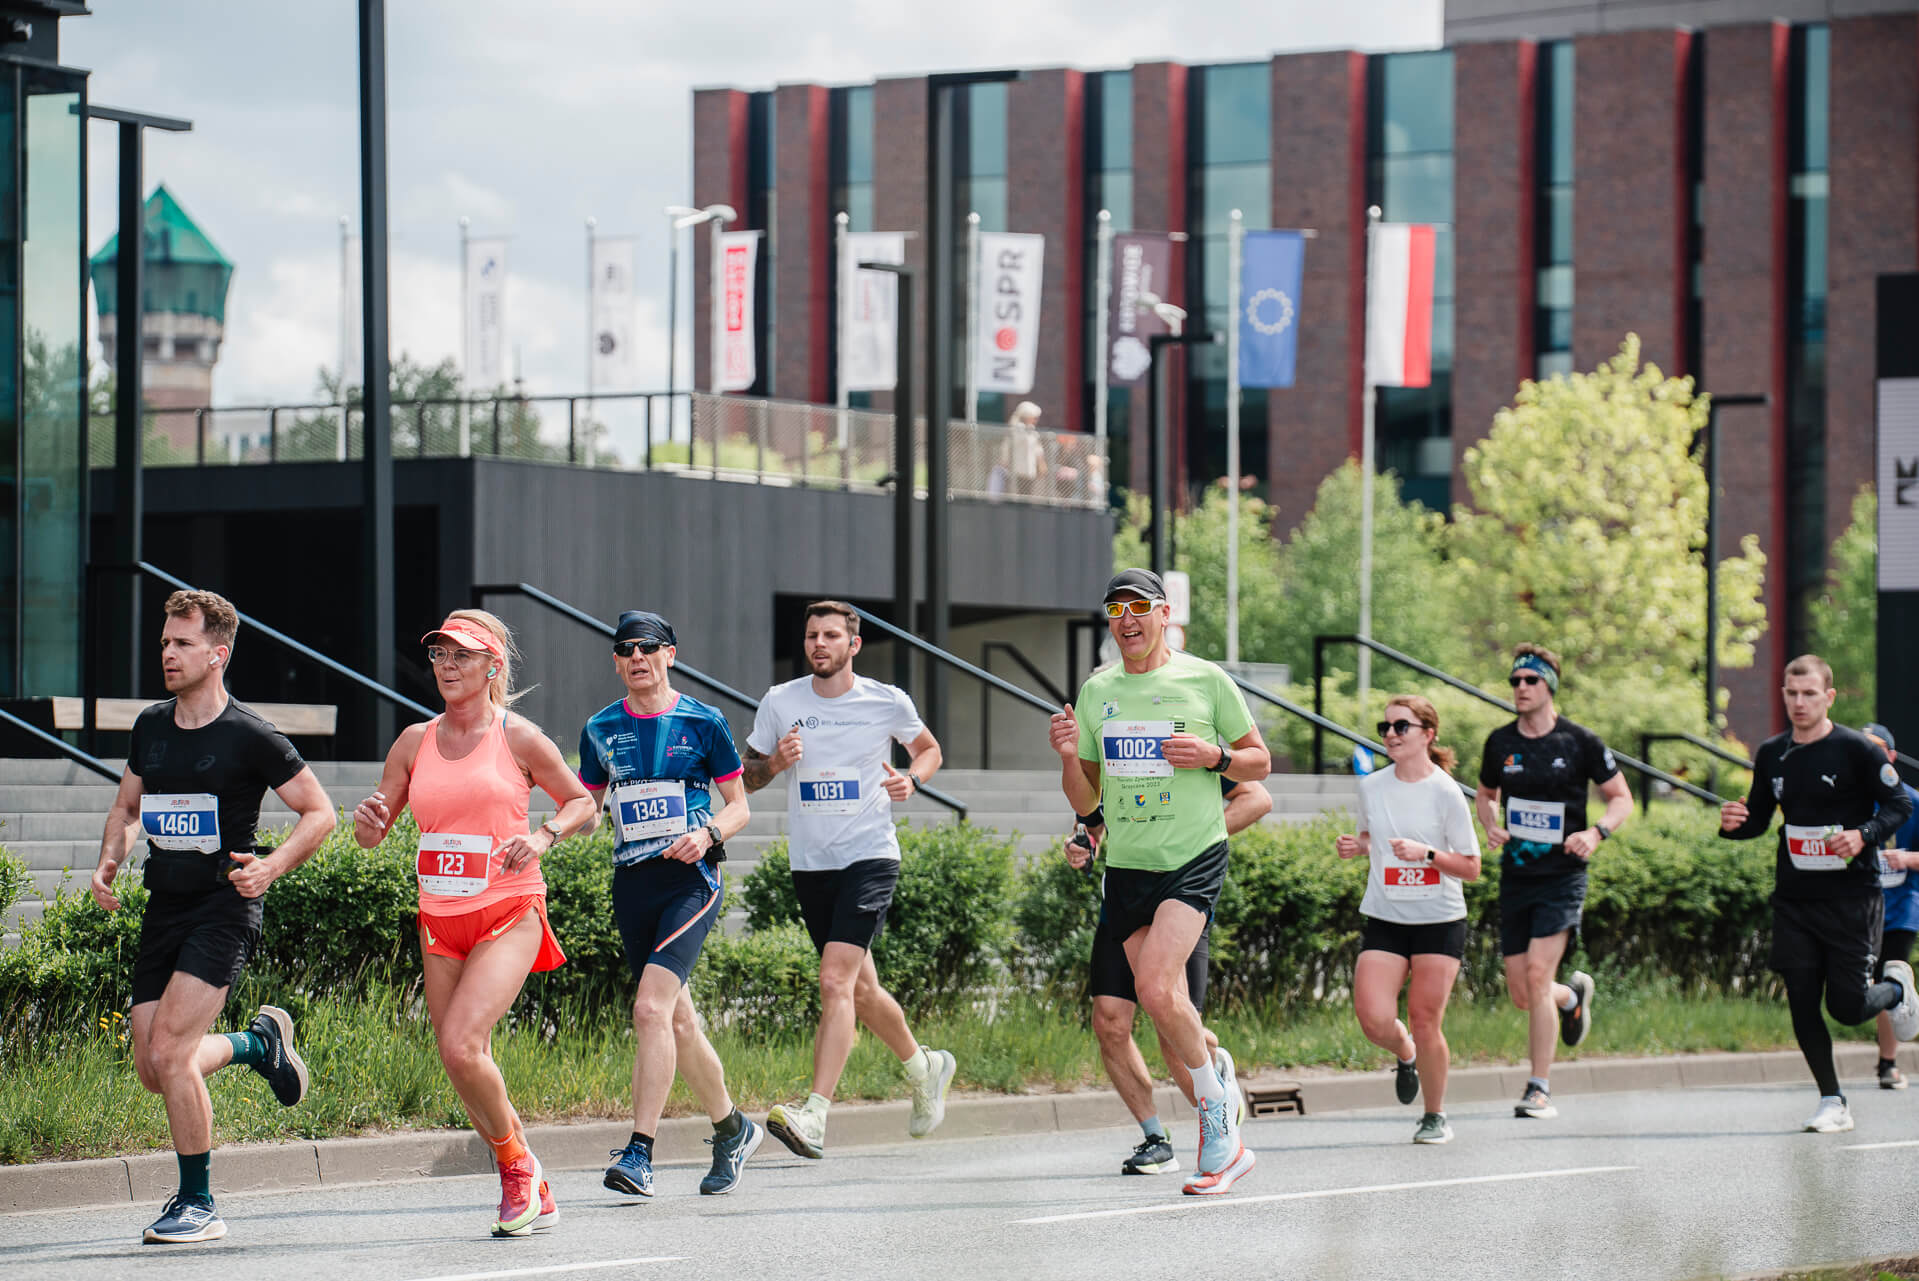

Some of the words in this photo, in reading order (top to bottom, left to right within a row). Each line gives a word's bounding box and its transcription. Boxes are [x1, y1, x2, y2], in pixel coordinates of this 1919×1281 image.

[1115, 738, 1157, 759] 1002
[812, 782, 844, 800] 1031
[632, 798, 668, 821] 1343
[157, 813, 200, 835] 1460
[1520, 811, 1550, 828] 1445
[1801, 839, 1826, 856] 401
[436, 853, 465, 876] 123
[1397, 868, 1425, 885] 282
